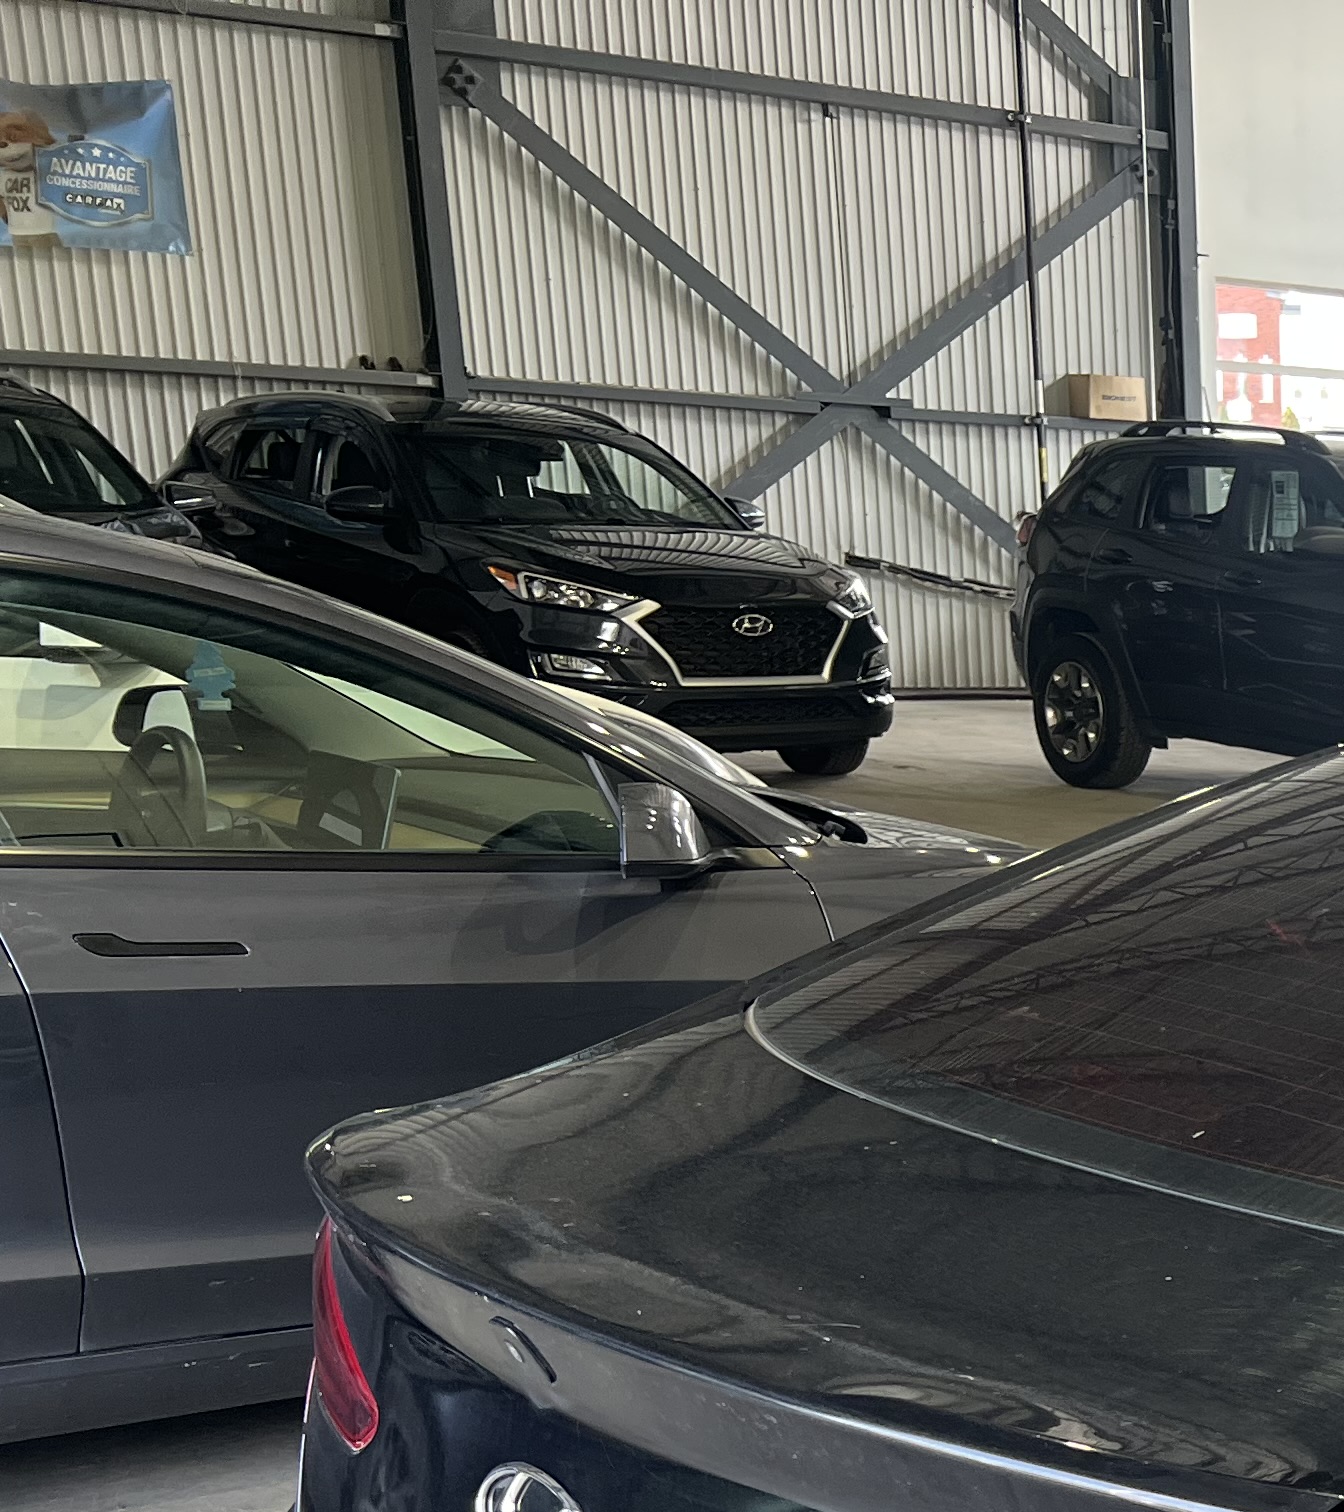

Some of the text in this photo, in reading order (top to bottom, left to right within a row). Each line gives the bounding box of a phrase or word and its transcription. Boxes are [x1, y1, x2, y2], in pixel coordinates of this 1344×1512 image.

[51, 157, 137, 184] AVANTAGE
[5, 177, 31, 194] CAR
[46, 174, 142, 197] CONCESSIONNAIRE
[66, 193, 125, 210] CARFAX
